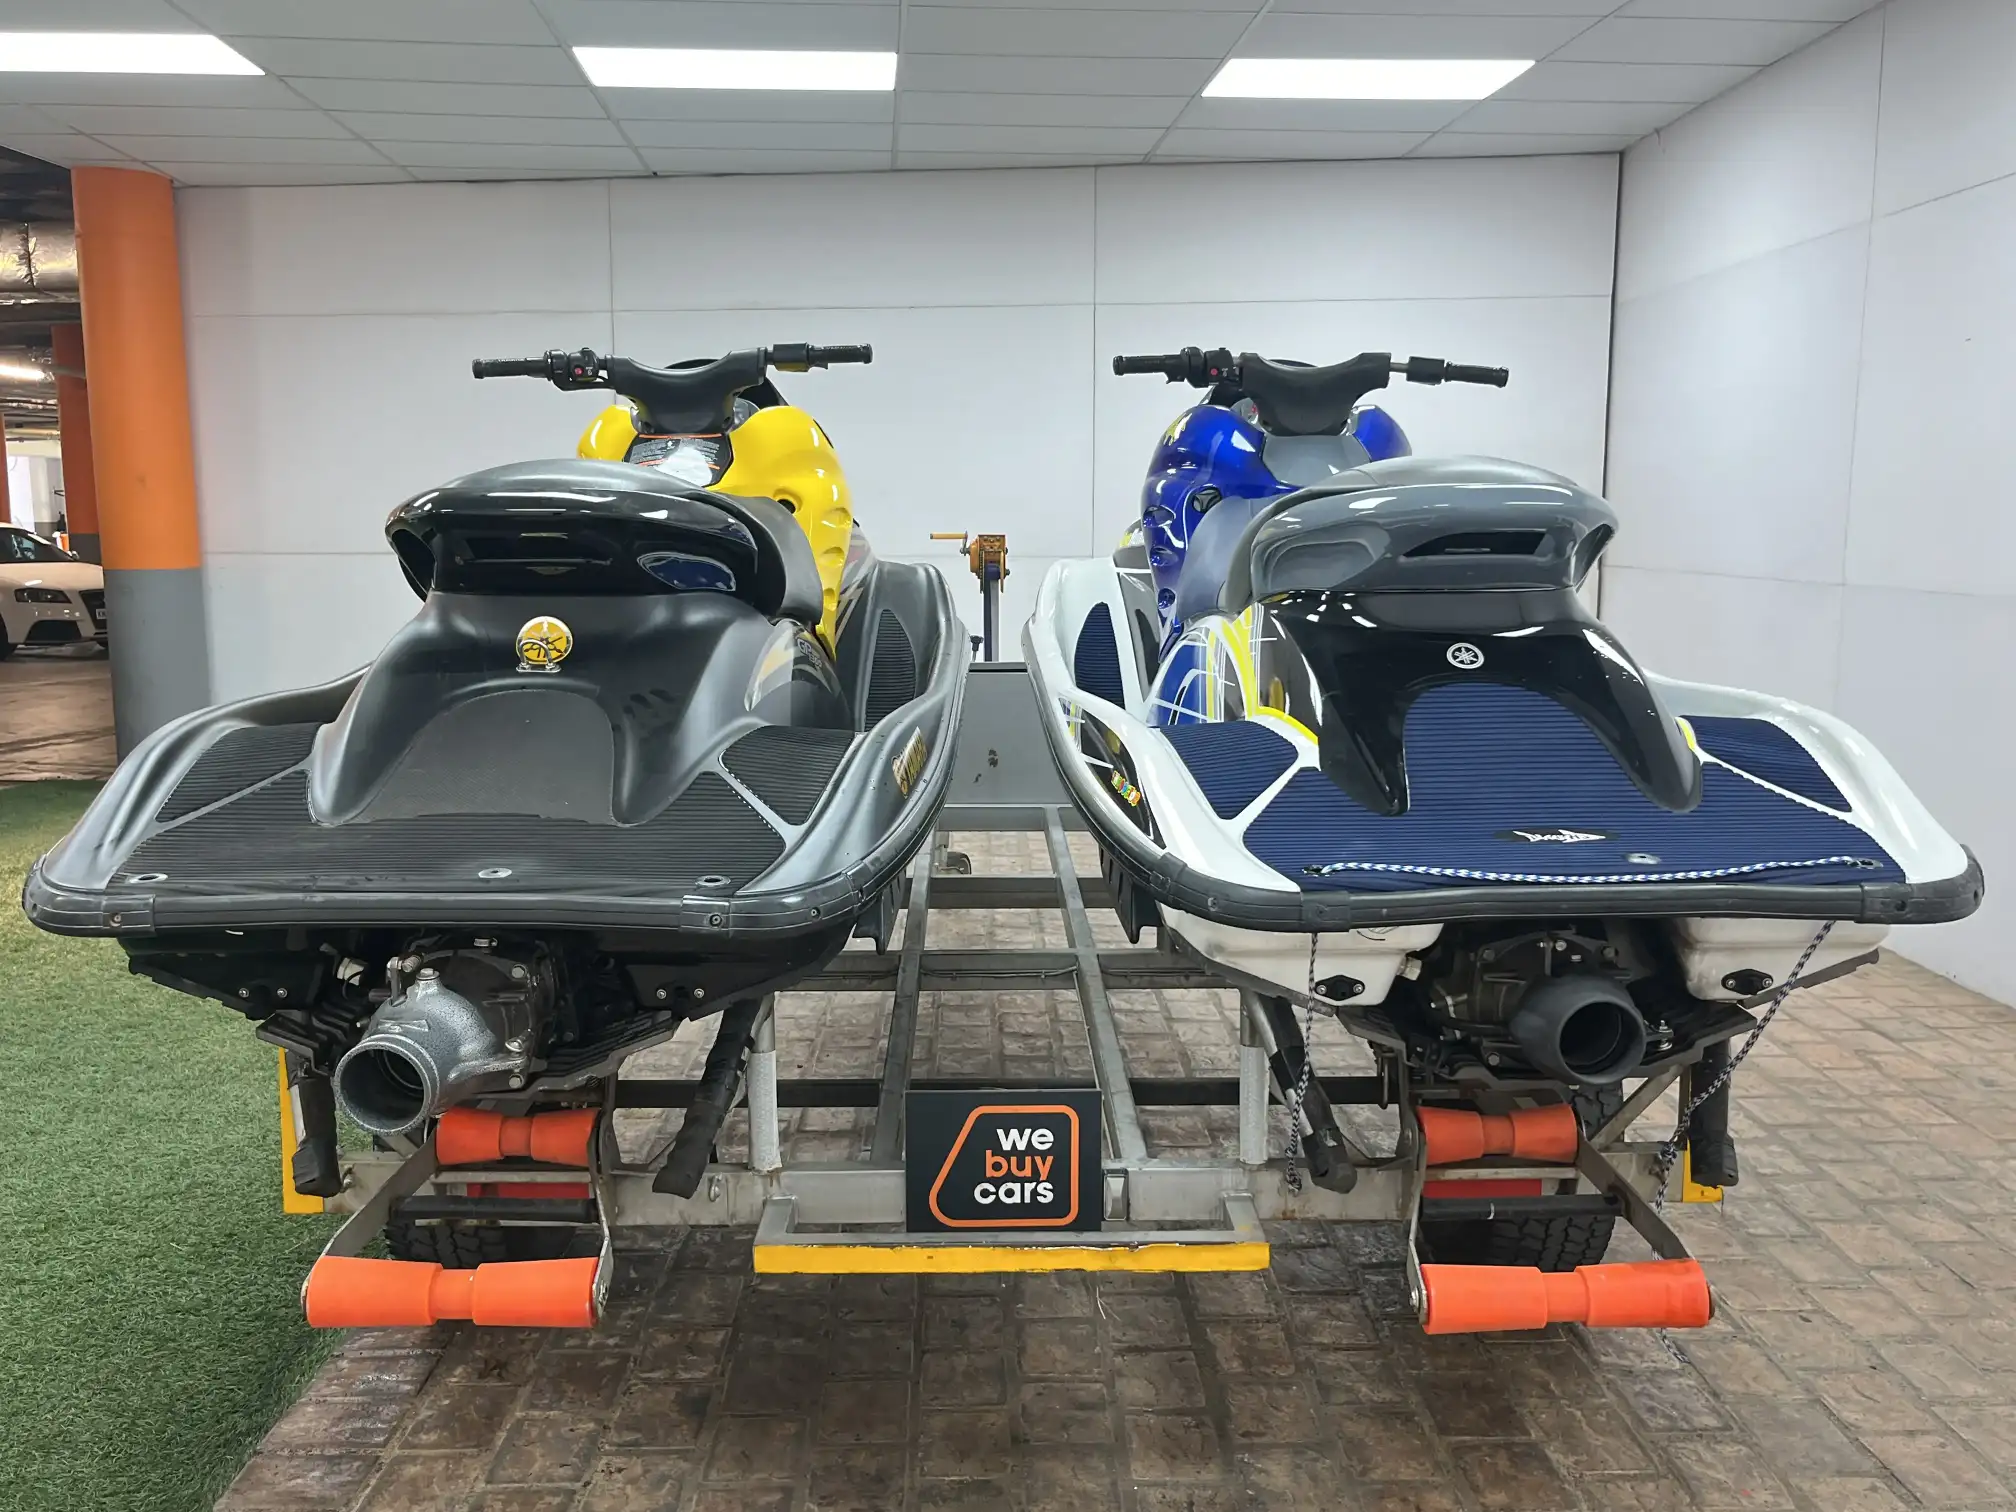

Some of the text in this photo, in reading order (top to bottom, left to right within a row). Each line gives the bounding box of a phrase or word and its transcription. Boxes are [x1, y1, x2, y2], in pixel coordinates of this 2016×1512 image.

[996, 1128, 1054, 1151] we
[985, 1150, 1054, 1180] buy
[973, 1181, 1054, 1205] cars
